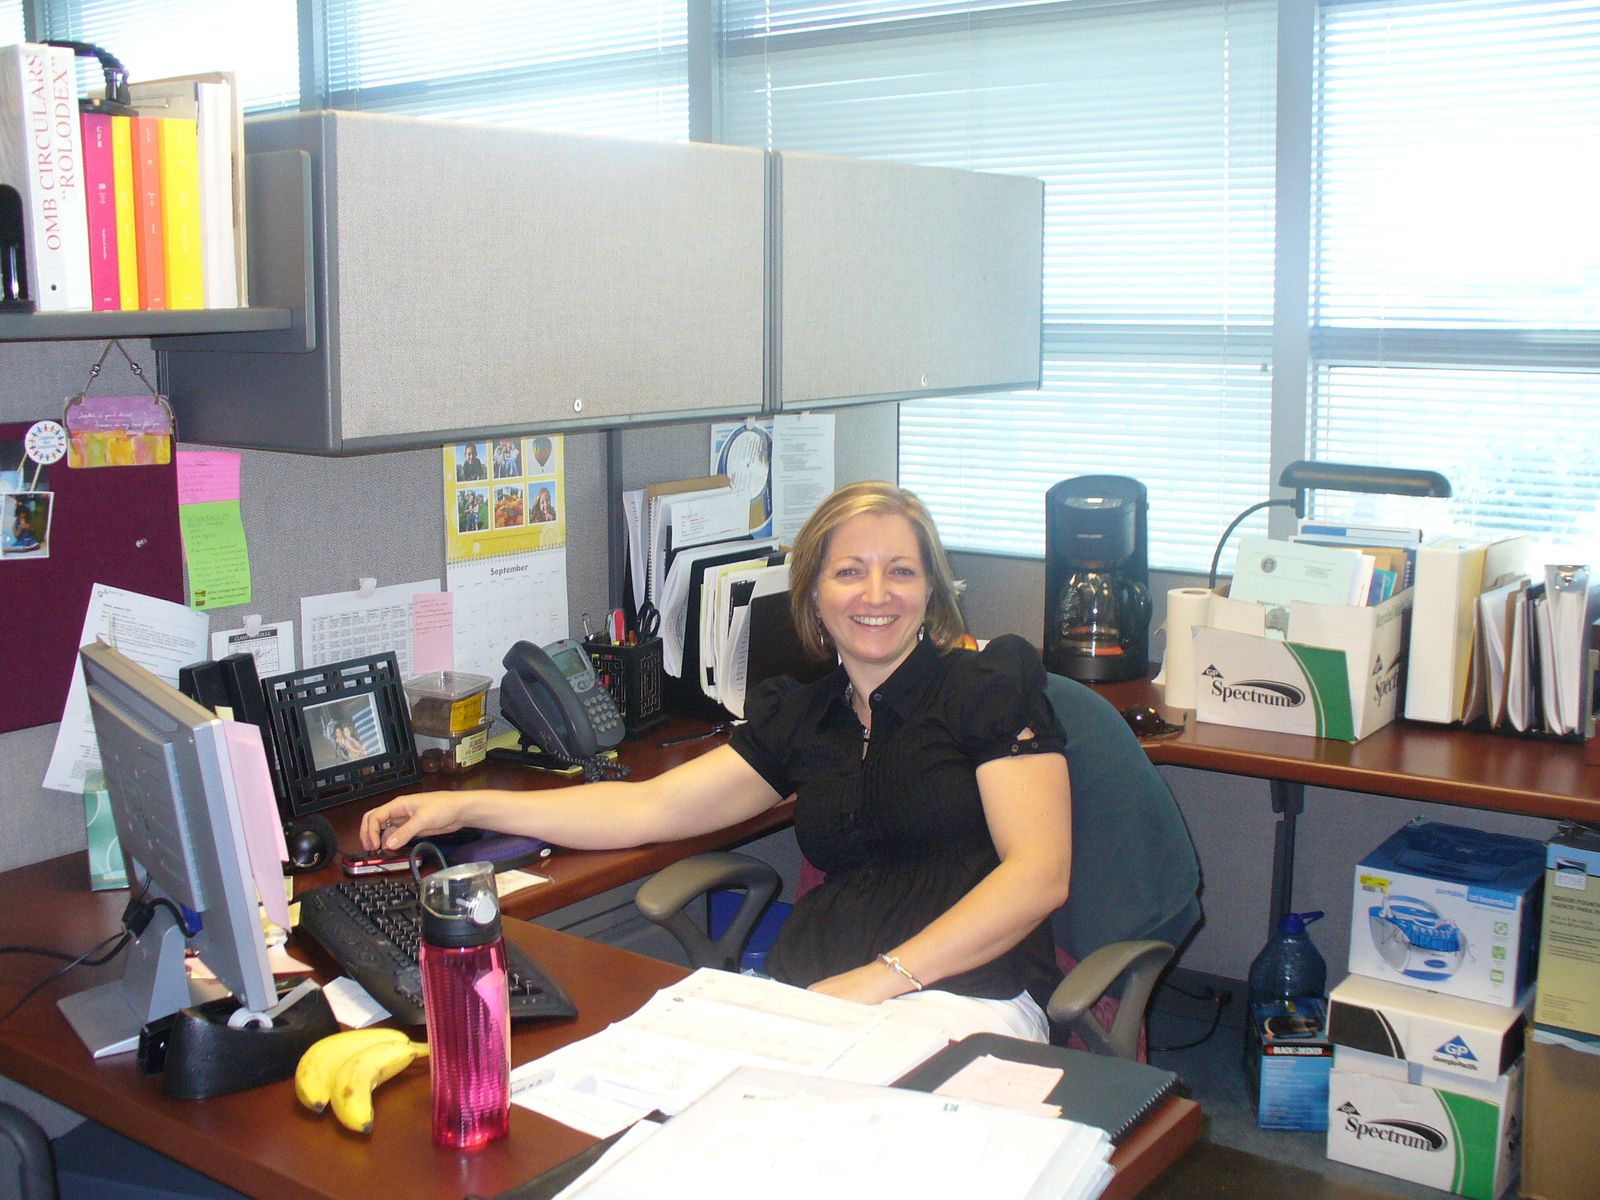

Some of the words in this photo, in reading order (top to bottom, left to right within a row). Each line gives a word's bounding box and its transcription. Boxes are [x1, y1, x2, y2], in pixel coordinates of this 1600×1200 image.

[26, 54, 54, 190] CIRCULARS
[43, 198, 61, 251] OMB
[490, 564, 529, 577] September
[1211, 679, 1292, 708] Spectrum
[1445, 1042, 1468, 1057] GP
[1345, 1117, 1434, 1152] Spectrum
